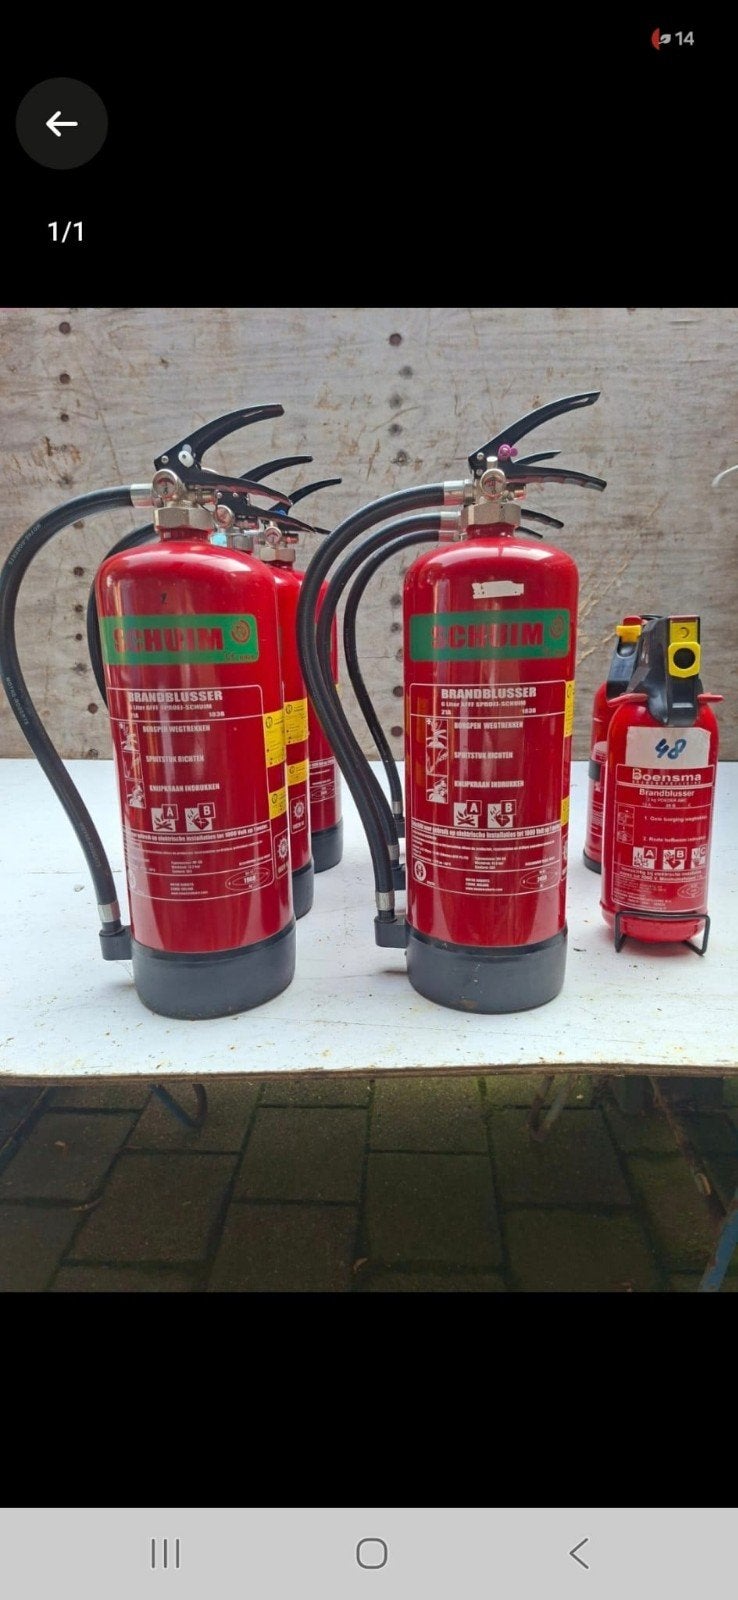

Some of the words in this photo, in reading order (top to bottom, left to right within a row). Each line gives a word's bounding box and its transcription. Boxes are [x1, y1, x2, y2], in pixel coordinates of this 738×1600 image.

[113, 627, 224, 652] SCHUIM
[432, 622, 544, 649] SCHUIM
[129, 690, 223, 703] BRANDBLUSSER
[440, 687, 537, 700] BRANDBLUSSER
[483, 721, 524, 729] WEGTREKKEN
[654, 738, 687, 759] 48
[487, 751, 514, 759] RICHTEN
[632, 767, 702, 782] Boensma
[639, 788, 695, 797] Brandblusser
[166, 808, 174, 817] A
[203, 805, 211, 815] B
[470, 802, 478, 813] A
[505, 802, 513, 813] B
[157, 834, 186, 842] elektrische
[456, 830, 486, 838] elektrische
[524, 828, 535, 836] 1000
[645, 849, 654, 857] A
[676, 850, 684, 858] B
